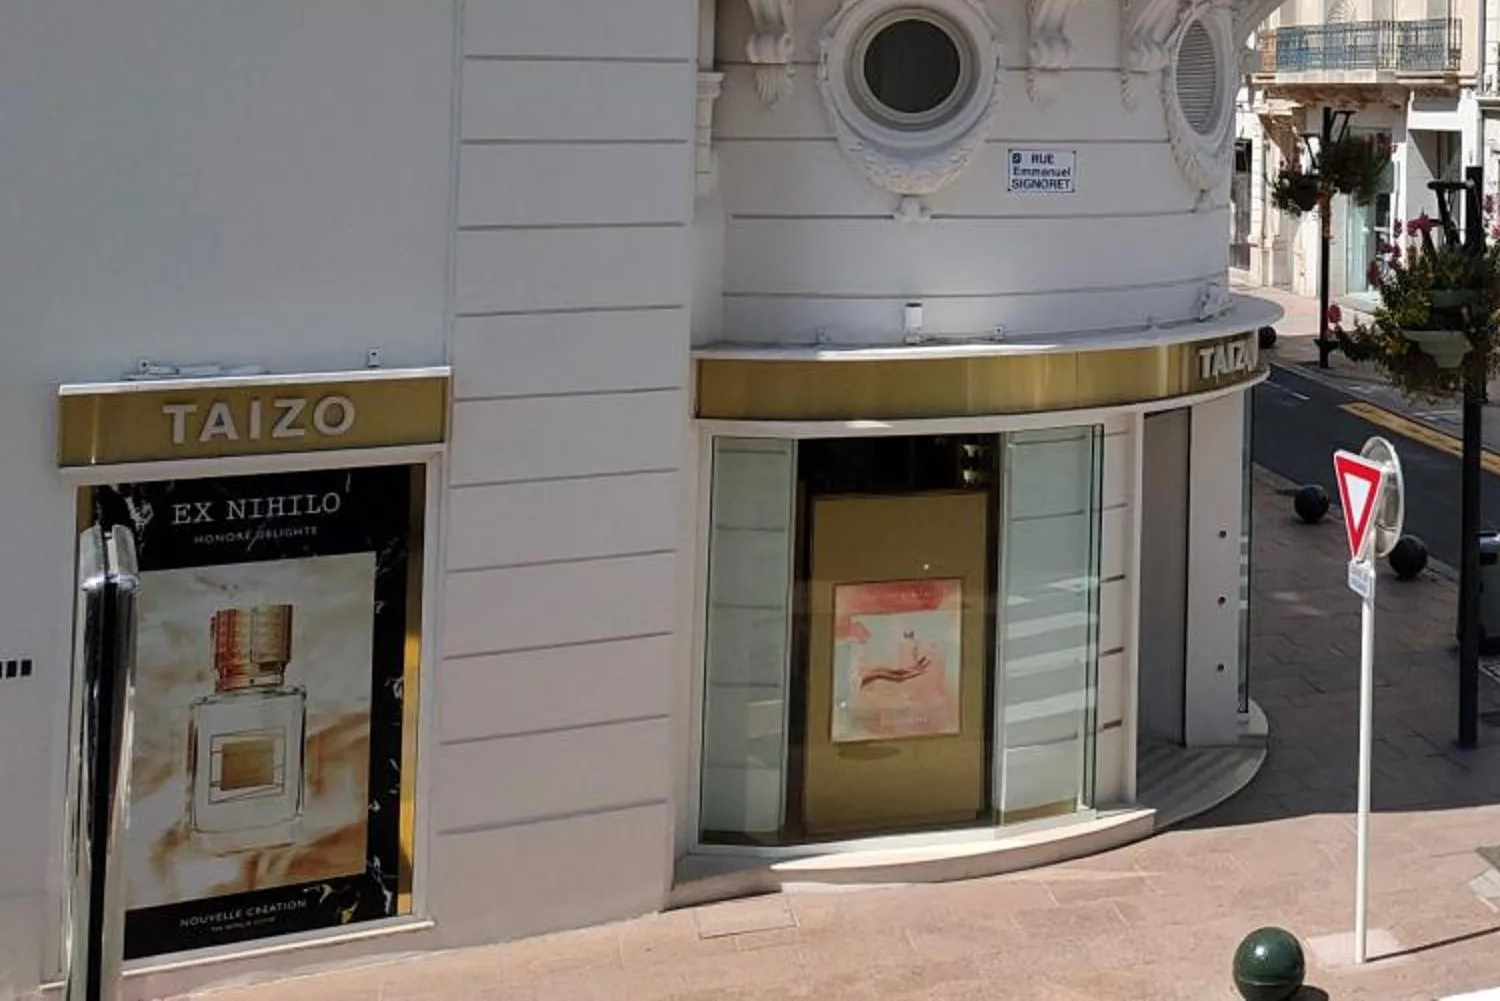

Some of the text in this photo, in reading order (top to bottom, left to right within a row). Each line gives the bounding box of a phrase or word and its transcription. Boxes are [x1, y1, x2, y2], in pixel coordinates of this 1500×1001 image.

[1031, 152, 1055, 164] RUE
[1013, 167, 1071, 177] Emmanuel
[1011, 179, 1071, 189] SIGNORET
[163, 395, 356, 444] TAIZO
[171, 492, 341, 525] EX NIHILO
